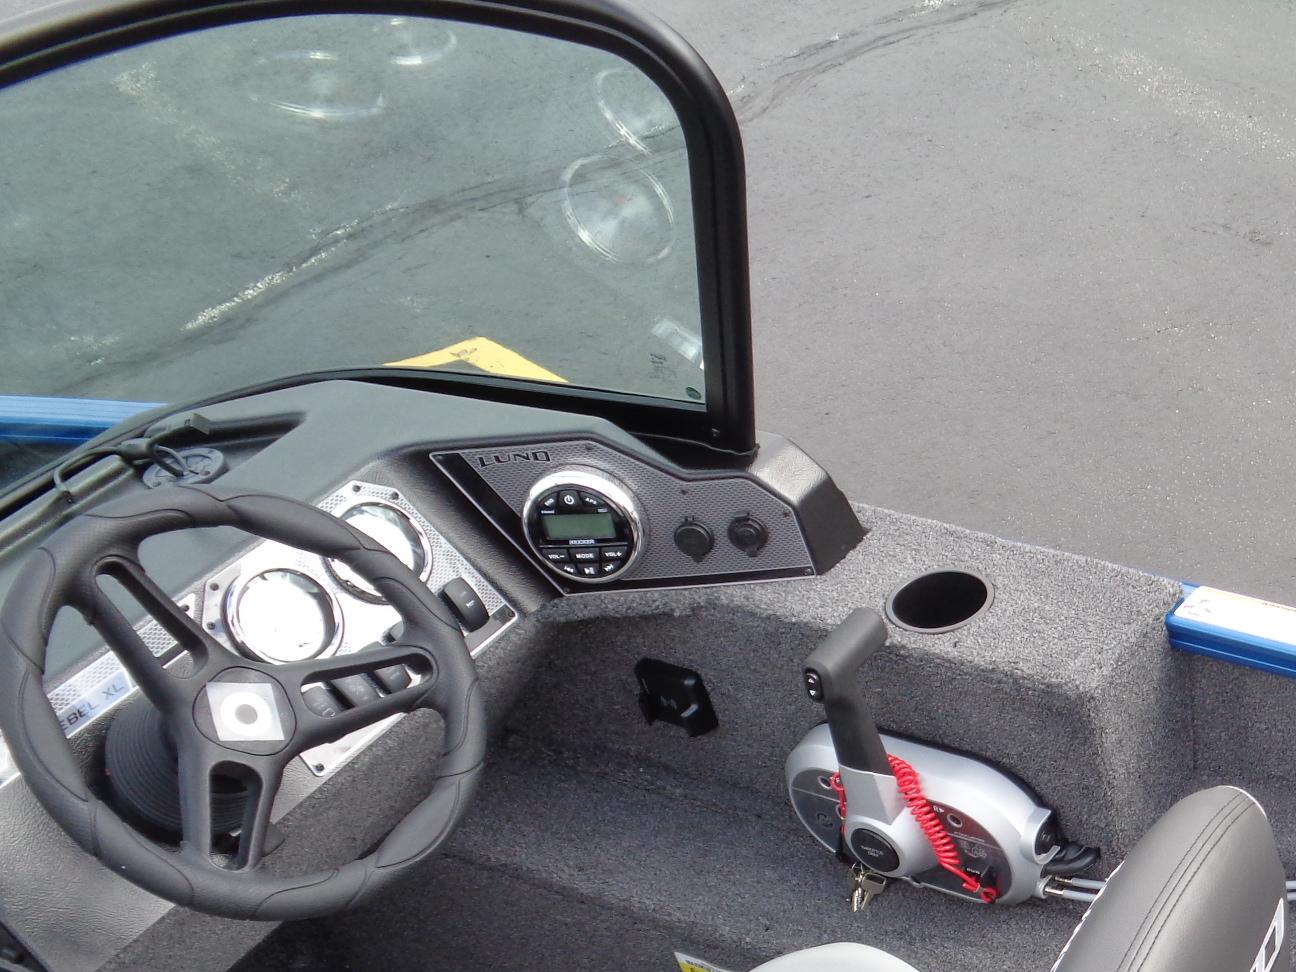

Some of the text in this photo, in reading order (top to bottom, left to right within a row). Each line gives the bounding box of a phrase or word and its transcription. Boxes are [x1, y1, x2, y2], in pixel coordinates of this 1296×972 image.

[478, 450, 551, 468] LUND
[59, 683, 125, 732] EBEL XL
